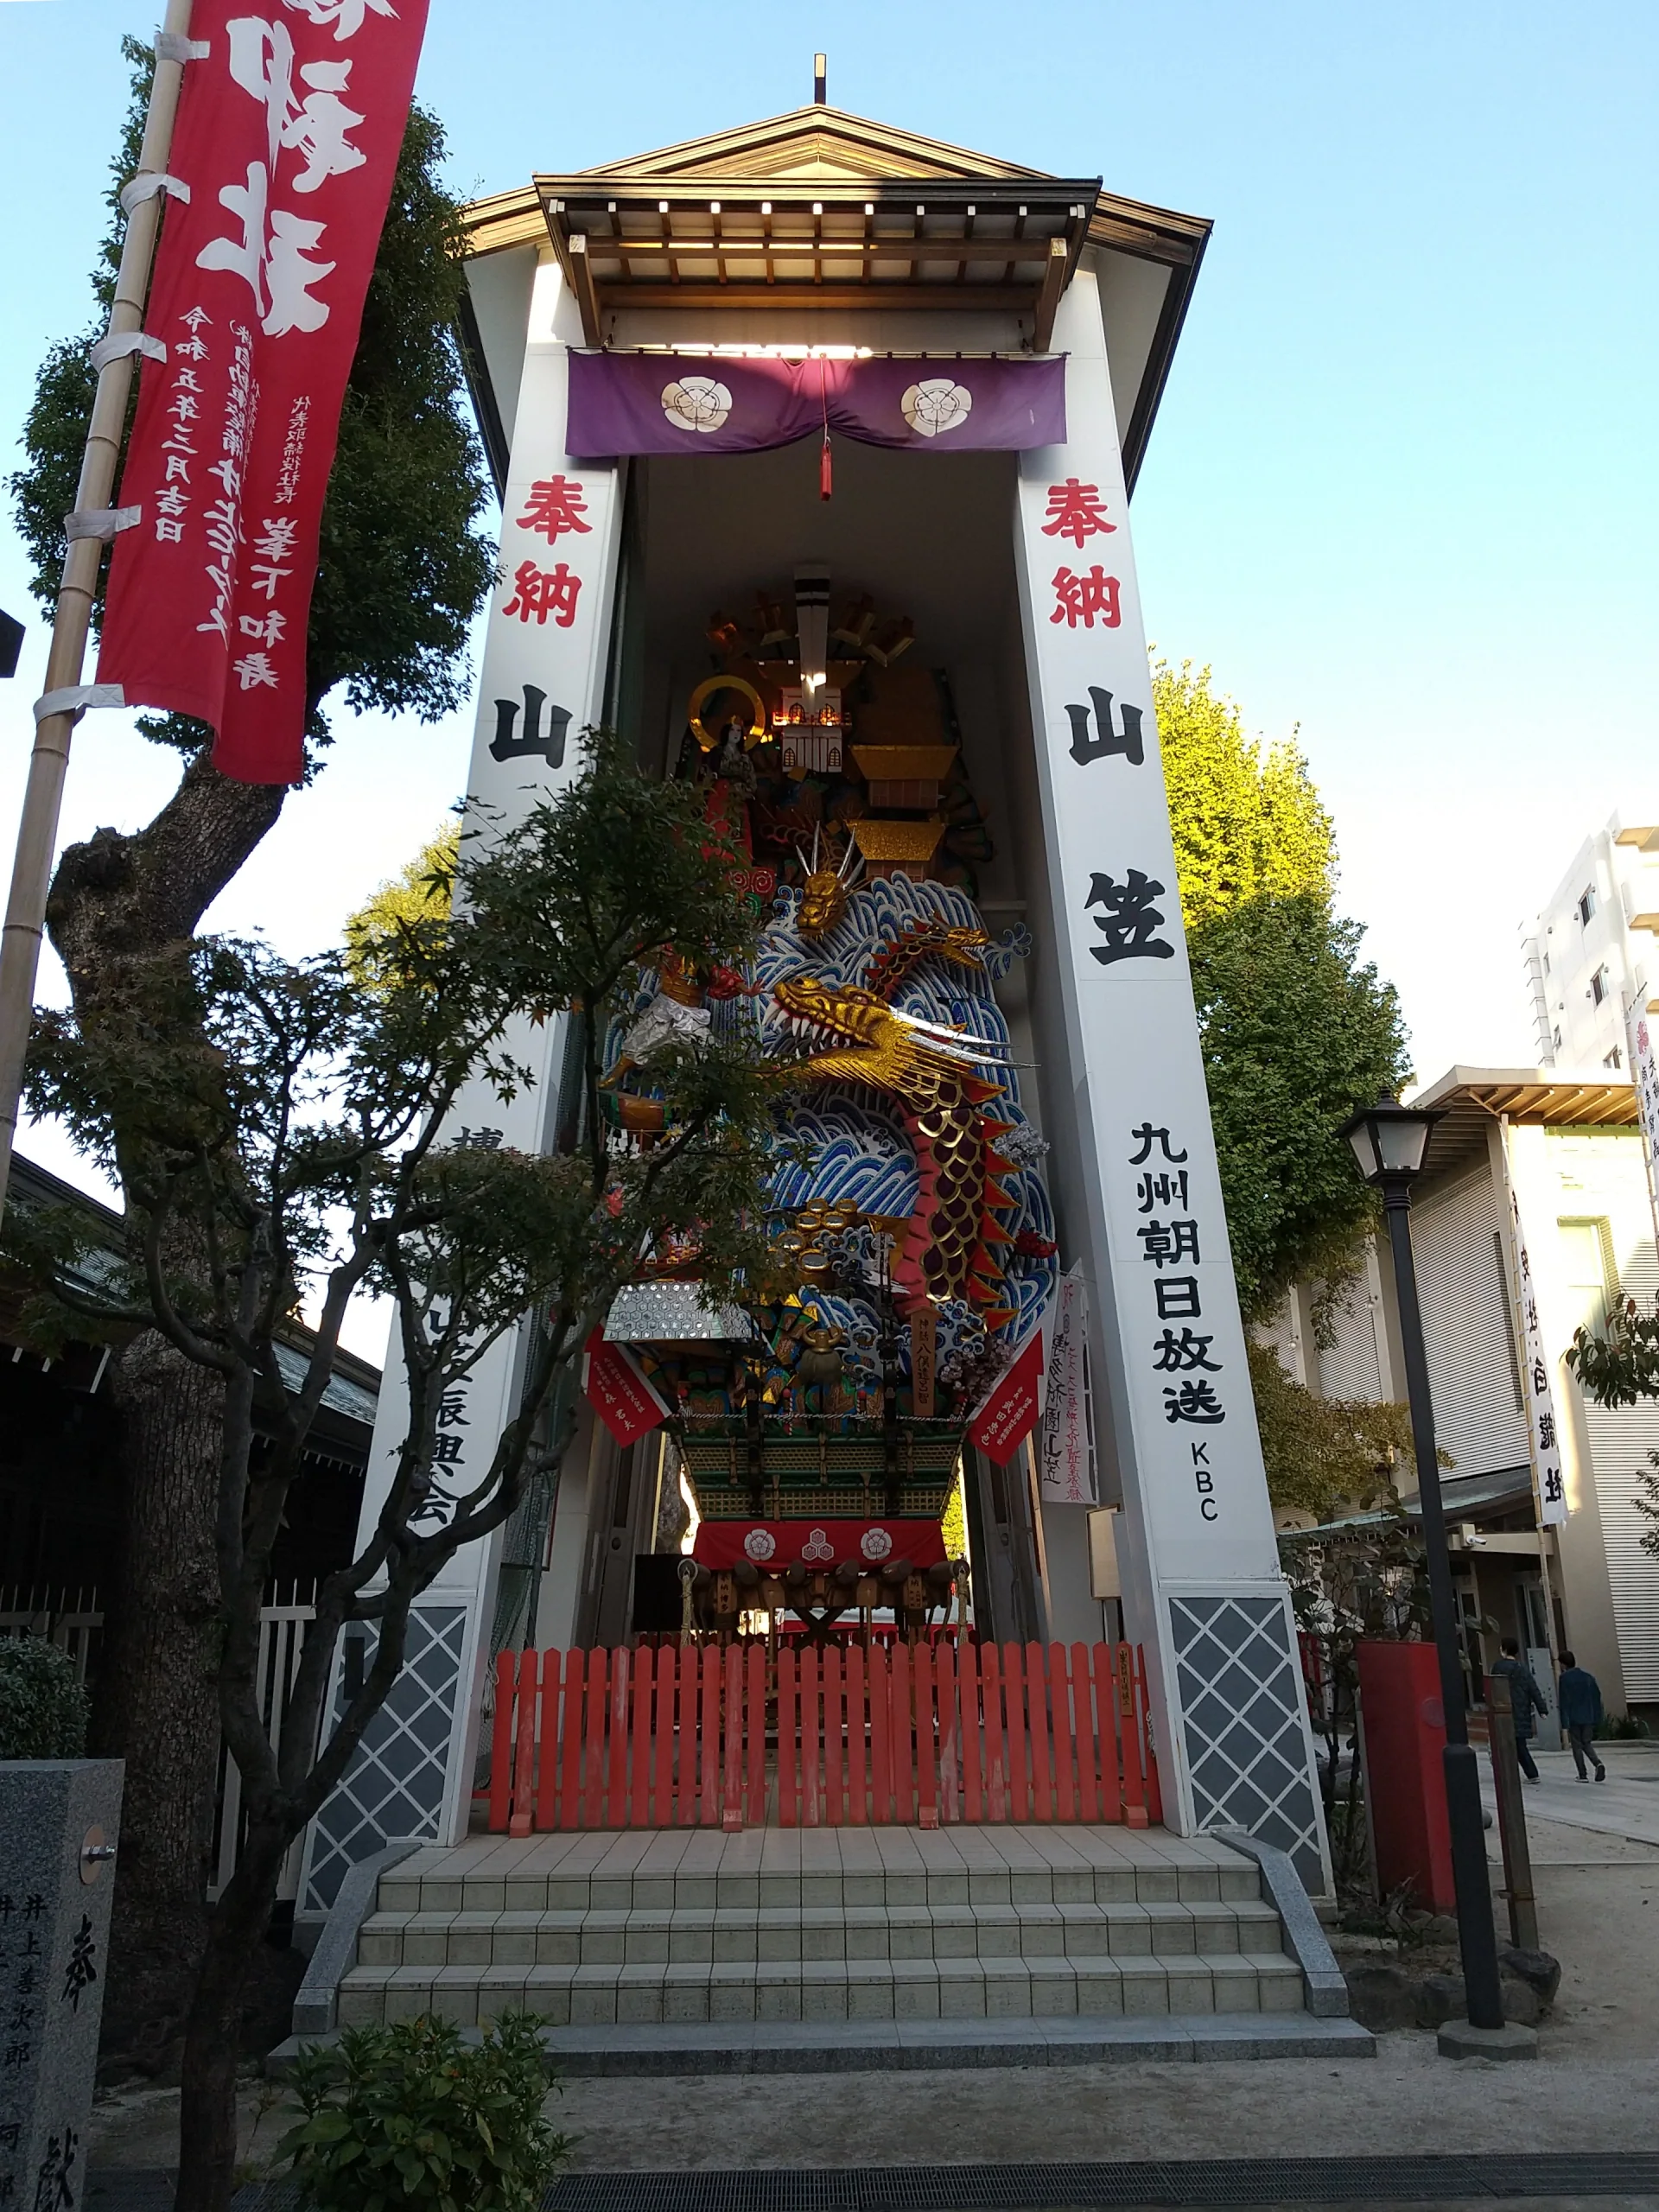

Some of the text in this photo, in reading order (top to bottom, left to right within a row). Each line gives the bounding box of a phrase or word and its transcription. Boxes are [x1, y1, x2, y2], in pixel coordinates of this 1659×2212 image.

[502, 474, 593, 628] 奉納
[1041, 477, 1226, 1425] 奉納 山笠 九州朝日放送
[1191, 1441, 1218, 1522] KBC
[5, 1893, 48, 2069] 井上善次郎
